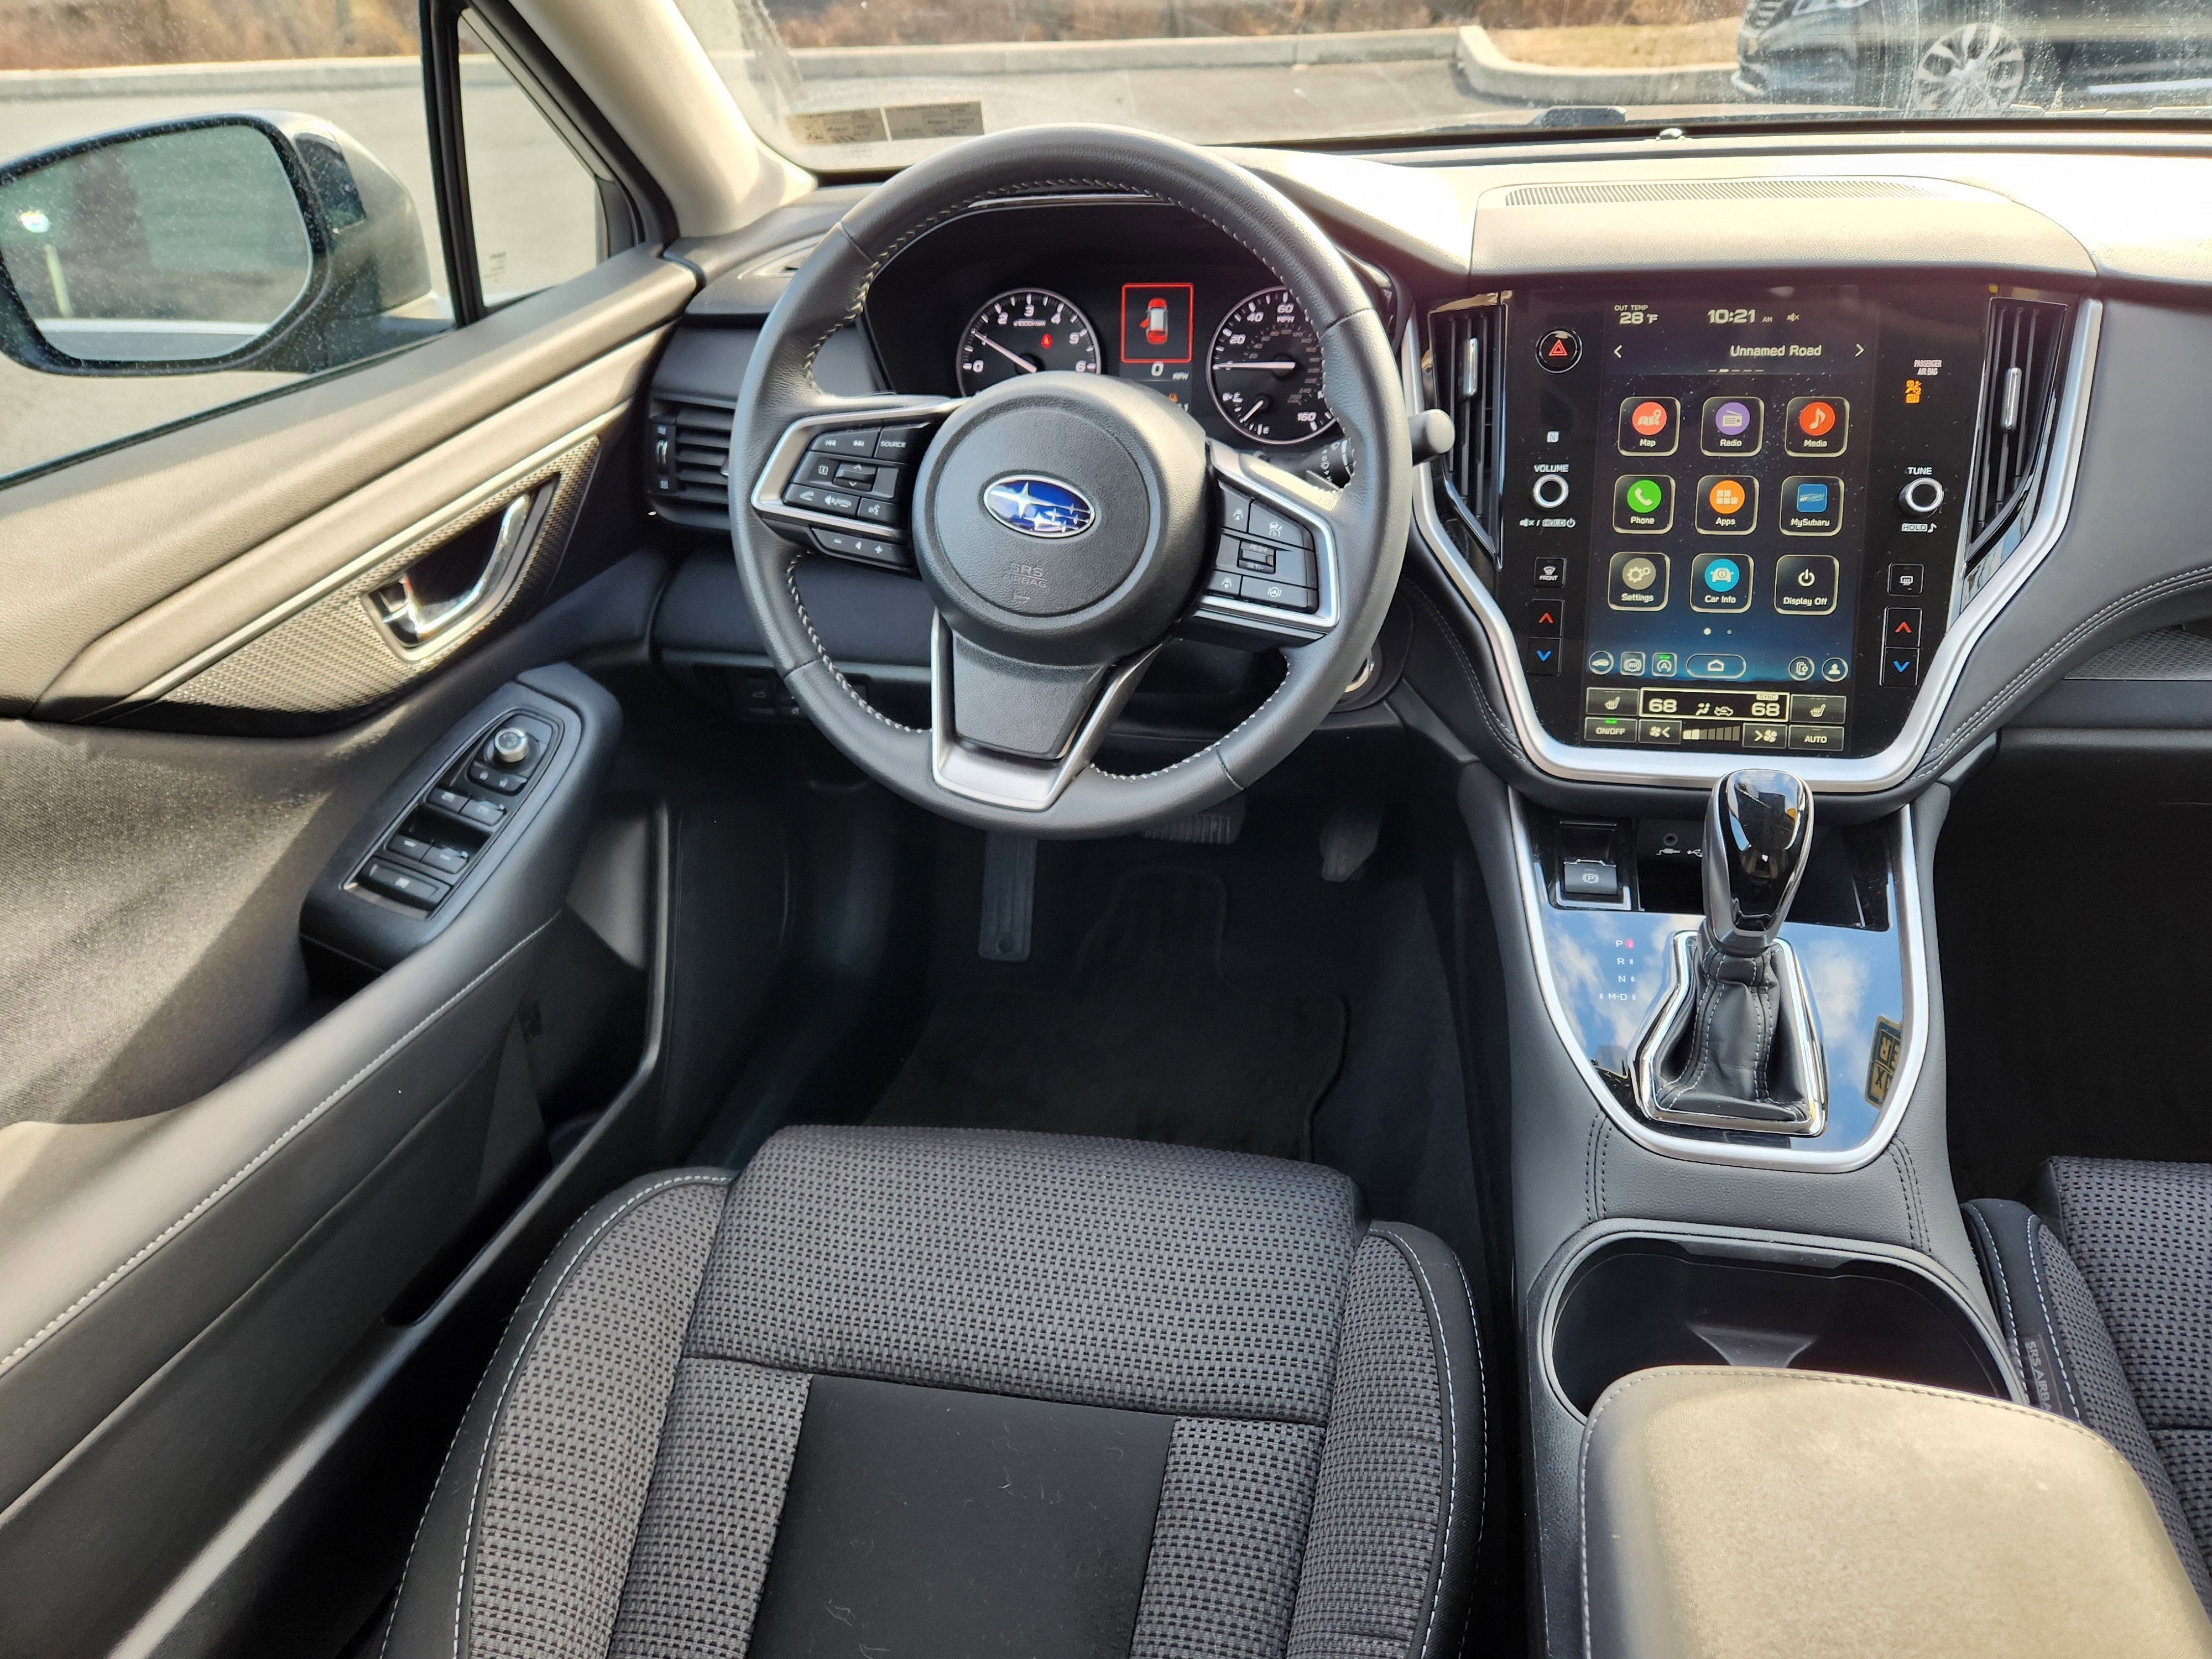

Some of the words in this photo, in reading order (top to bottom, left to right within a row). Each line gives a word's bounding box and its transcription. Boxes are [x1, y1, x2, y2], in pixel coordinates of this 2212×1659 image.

[1024, 304, 1035, 317] 3
[1277, 304, 1294, 313] 60
[998, 312, 1009, 325] 2
[1051, 312, 1061, 324] 4
[1247, 311, 1264, 322] 40
[1276, 315, 1295, 323] MPH
[1619, 311, 1644, 324] 28
[1707, 309, 1756, 324] 10:21
[1069, 332, 1079, 345] 5
[1229, 334, 1246, 344] 20
[1730, 345, 1785, 357] Unnamed
[1789, 345, 1822, 357] Road
[973, 360, 984, 372] 0
[1075, 360, 1087, 372] 6
[1151, 361, 1164, 376] 0
[1297, 411, 1317, 421] 160
[1639, 439, 1656, 448] Map
[1719, 439, 1743, 447] Radio
[1803, 439, 1828, 447] Media
[1533, 464, 1569, 473] VOLUME
[1907, 467, 1933, 475] TUNE
[1630, 516, 1655, 525] Phone
[1715, 517, 1736, 526] Apps
[1790, 518, 1830, 529] MySubaru
[1010, 562, 1044, 577] SRS
[1002, 573, 1047, 588] AIRBAG
[1621, 593, 1655, 603] Settings
[1704, 594, 1719, 603] Car
[1721, 594, 1736, 604] Info
[1782, 596, 1813, 607] Display
[1814, 597, 1828, 606] Off
[1648, 698, 1677, 713] 68
[1751, 702, 1780, 716] 68
[1595, 727, 1625, 736] ON/OFF
[1804, 734, 1827, 744] AUTO
[2028, 1341, 2041, 1366] SRS
[2034, 1370, 2052, 1411] AIRBA
